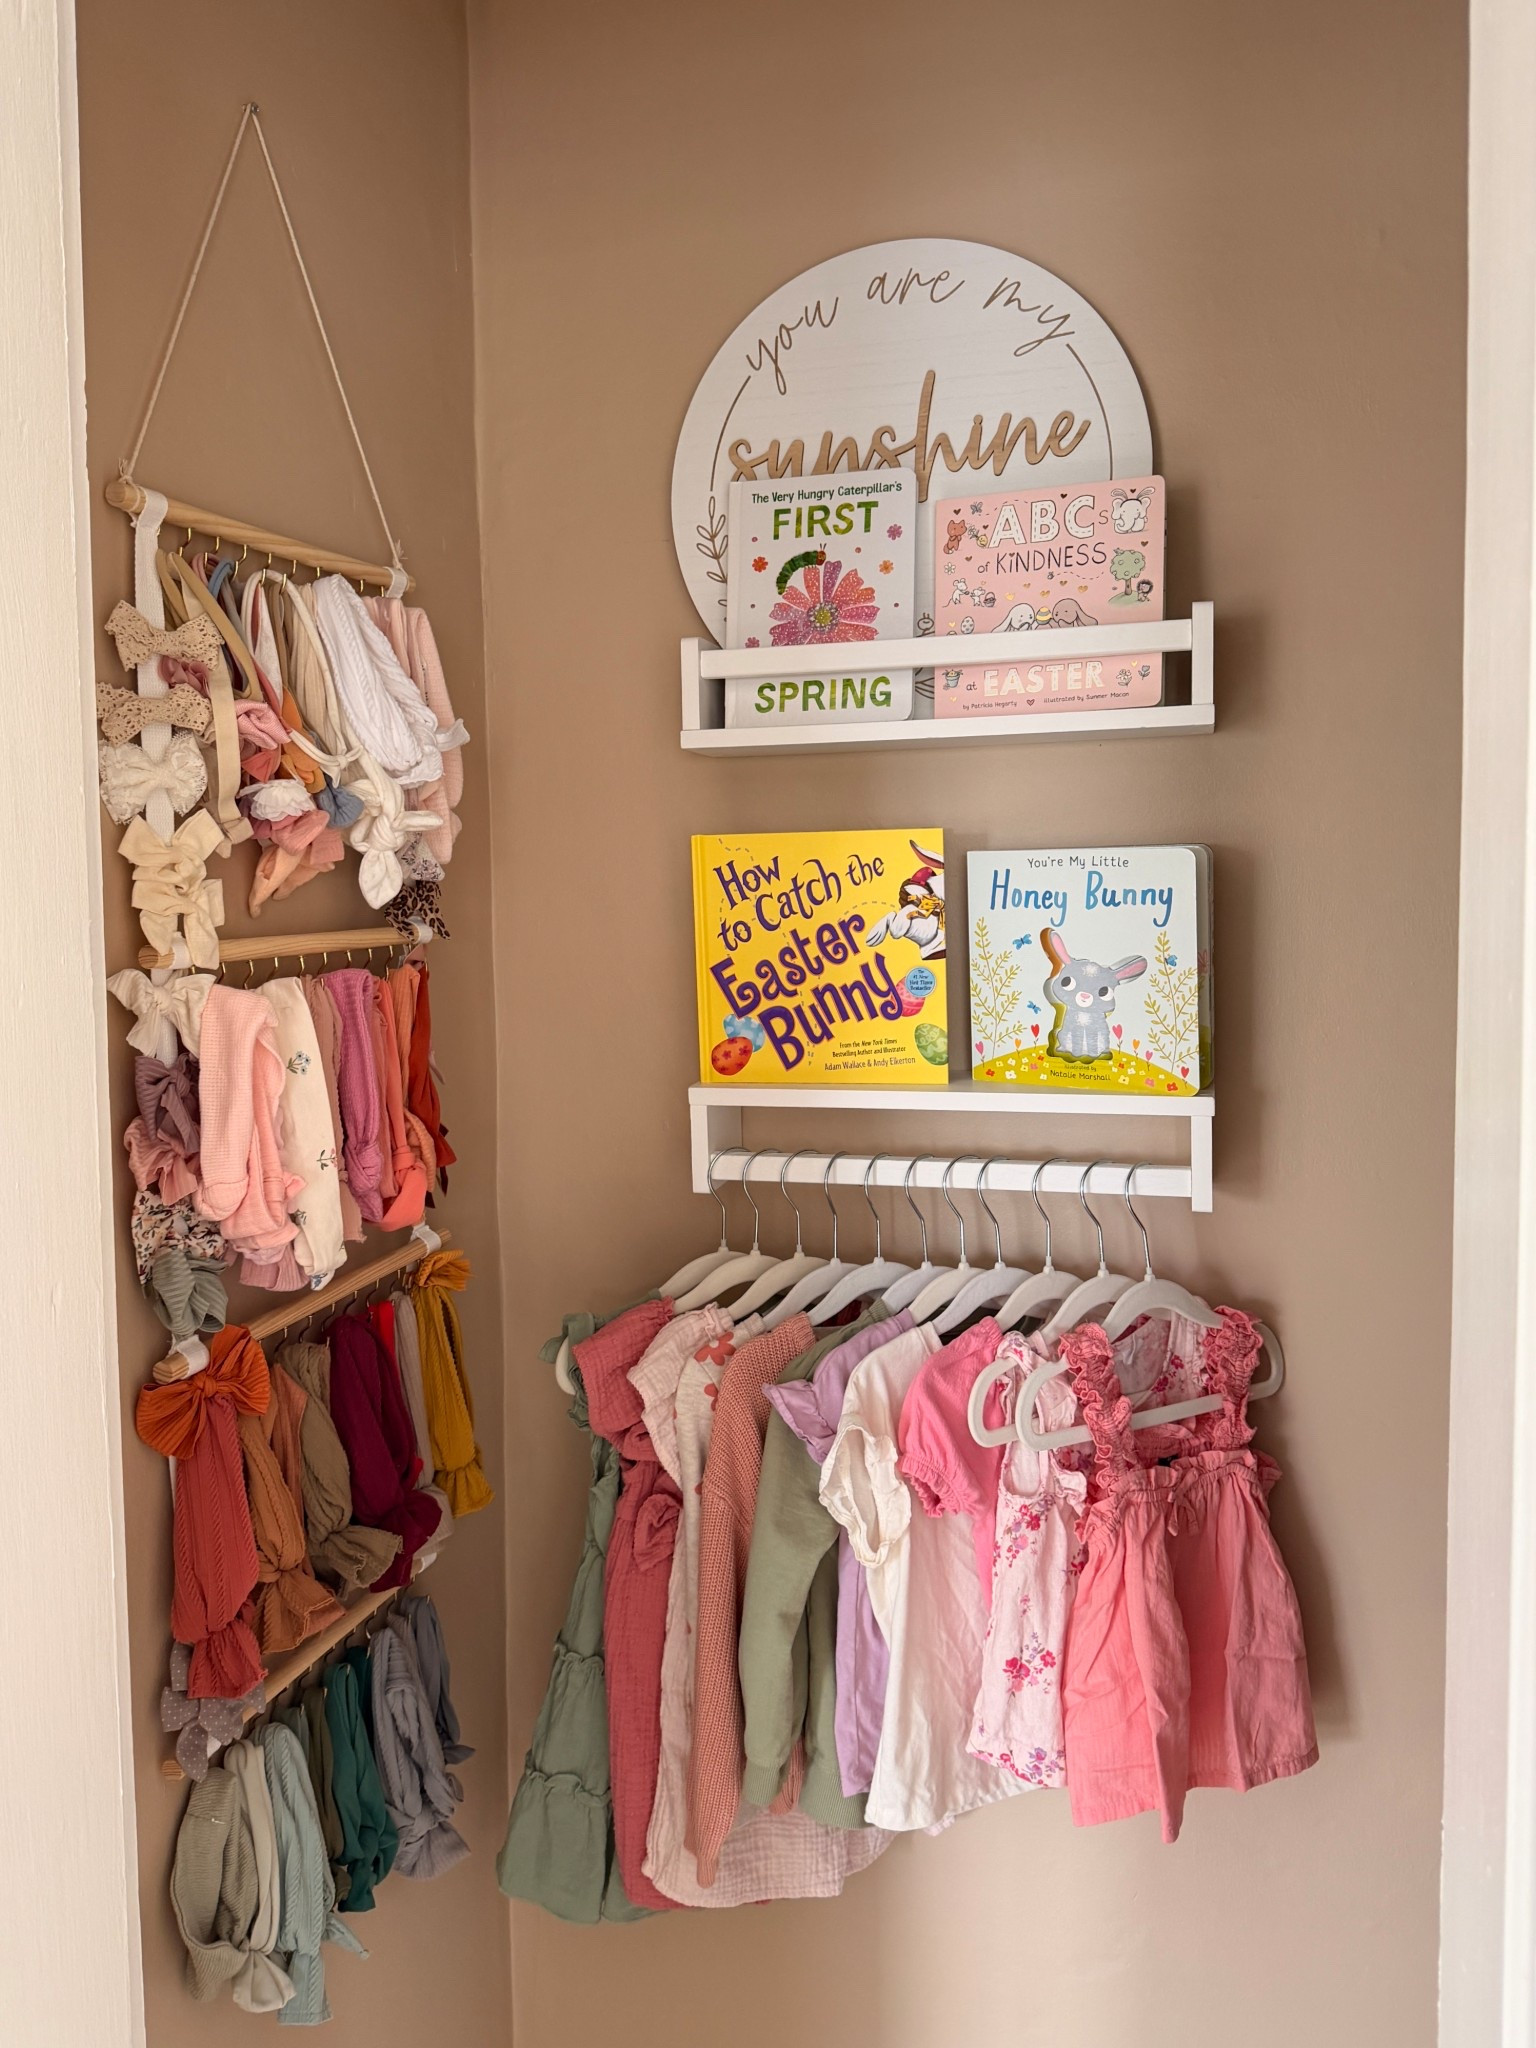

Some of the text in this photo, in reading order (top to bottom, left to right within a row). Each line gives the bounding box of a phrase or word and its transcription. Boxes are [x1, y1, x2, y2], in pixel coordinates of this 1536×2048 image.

[746, 267, 1076, 395] you are my
[728, 369, 1092, 503] sunshine
[752, 481, 903, 504] The Very Hungry Caterpillar's
[773, 500, 879, 541] FIRST
[977, 561, 990, 574] of
[754, 675, 892, 713] SPRING
[966, 660, 1104, 697] at EASTER
[994, 700, 1018, 709] Hegarty
[1027, 855, 1130, 869] You're My Little
[712, 855, 782, 910] How
[990, 868, 1174, 927] Honey Bunny
[716, 854, 885, 953] to Catch the
[709, 913, 866, 1020] Easter
[757, 951, 904, 1072] Bunny
[824, 1062, 842, 1071] Adam
[842, 1061, 866, 1069] Wallace
[867, 1059, 872, 1067] &
[873, 1058, 889, 1068] Andy
[1051, 1069, 1076, 1078] Natalie
